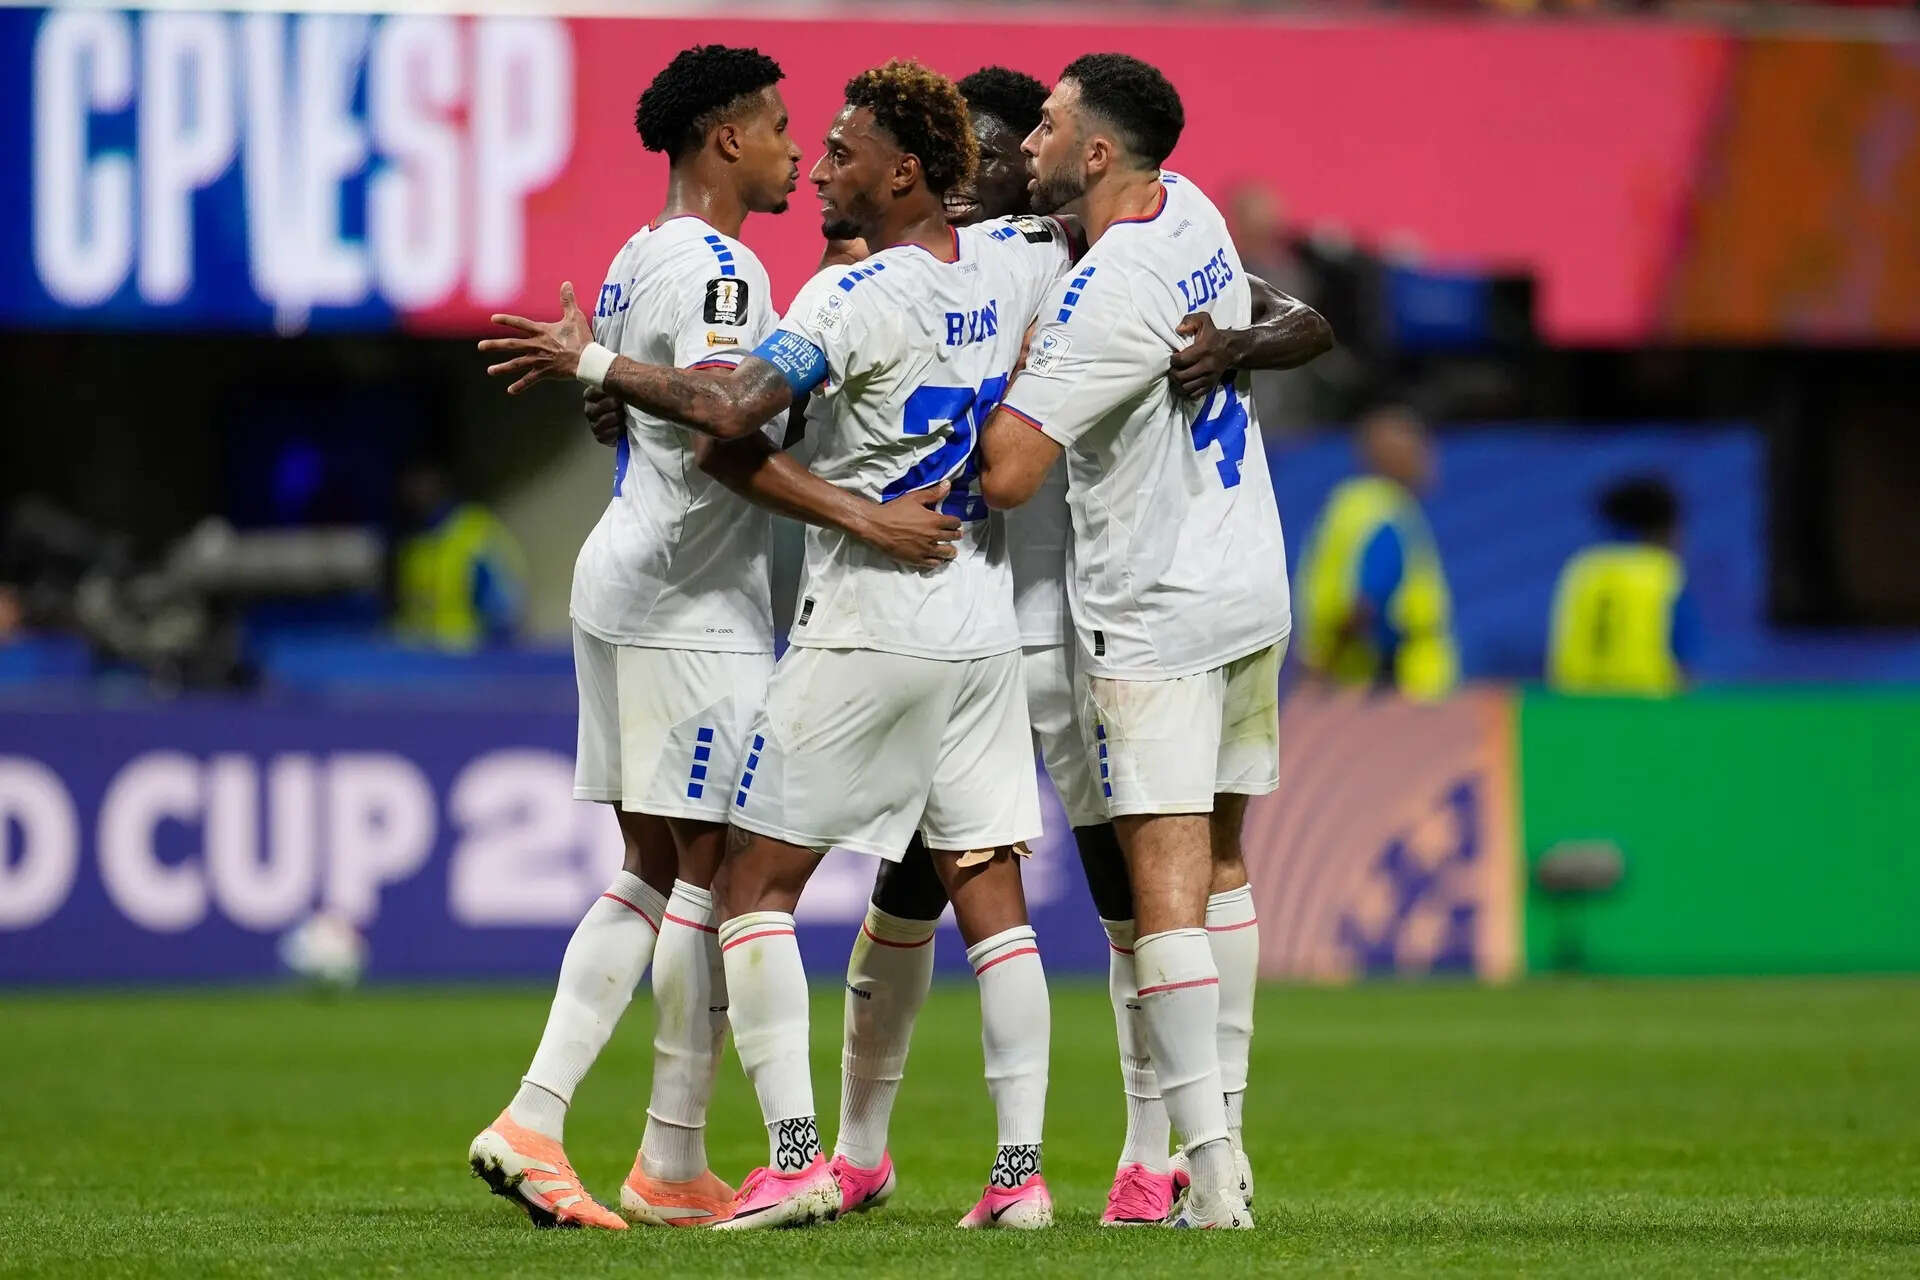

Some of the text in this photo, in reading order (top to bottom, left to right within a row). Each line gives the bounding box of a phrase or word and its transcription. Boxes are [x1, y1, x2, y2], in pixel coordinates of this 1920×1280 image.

[1177, 248, 1233, 312] LOPES
[778, 336, 815, 370] UNITES
[1190, 383, 1248, 489] 4
[98, 750, 437, 931] CUP
